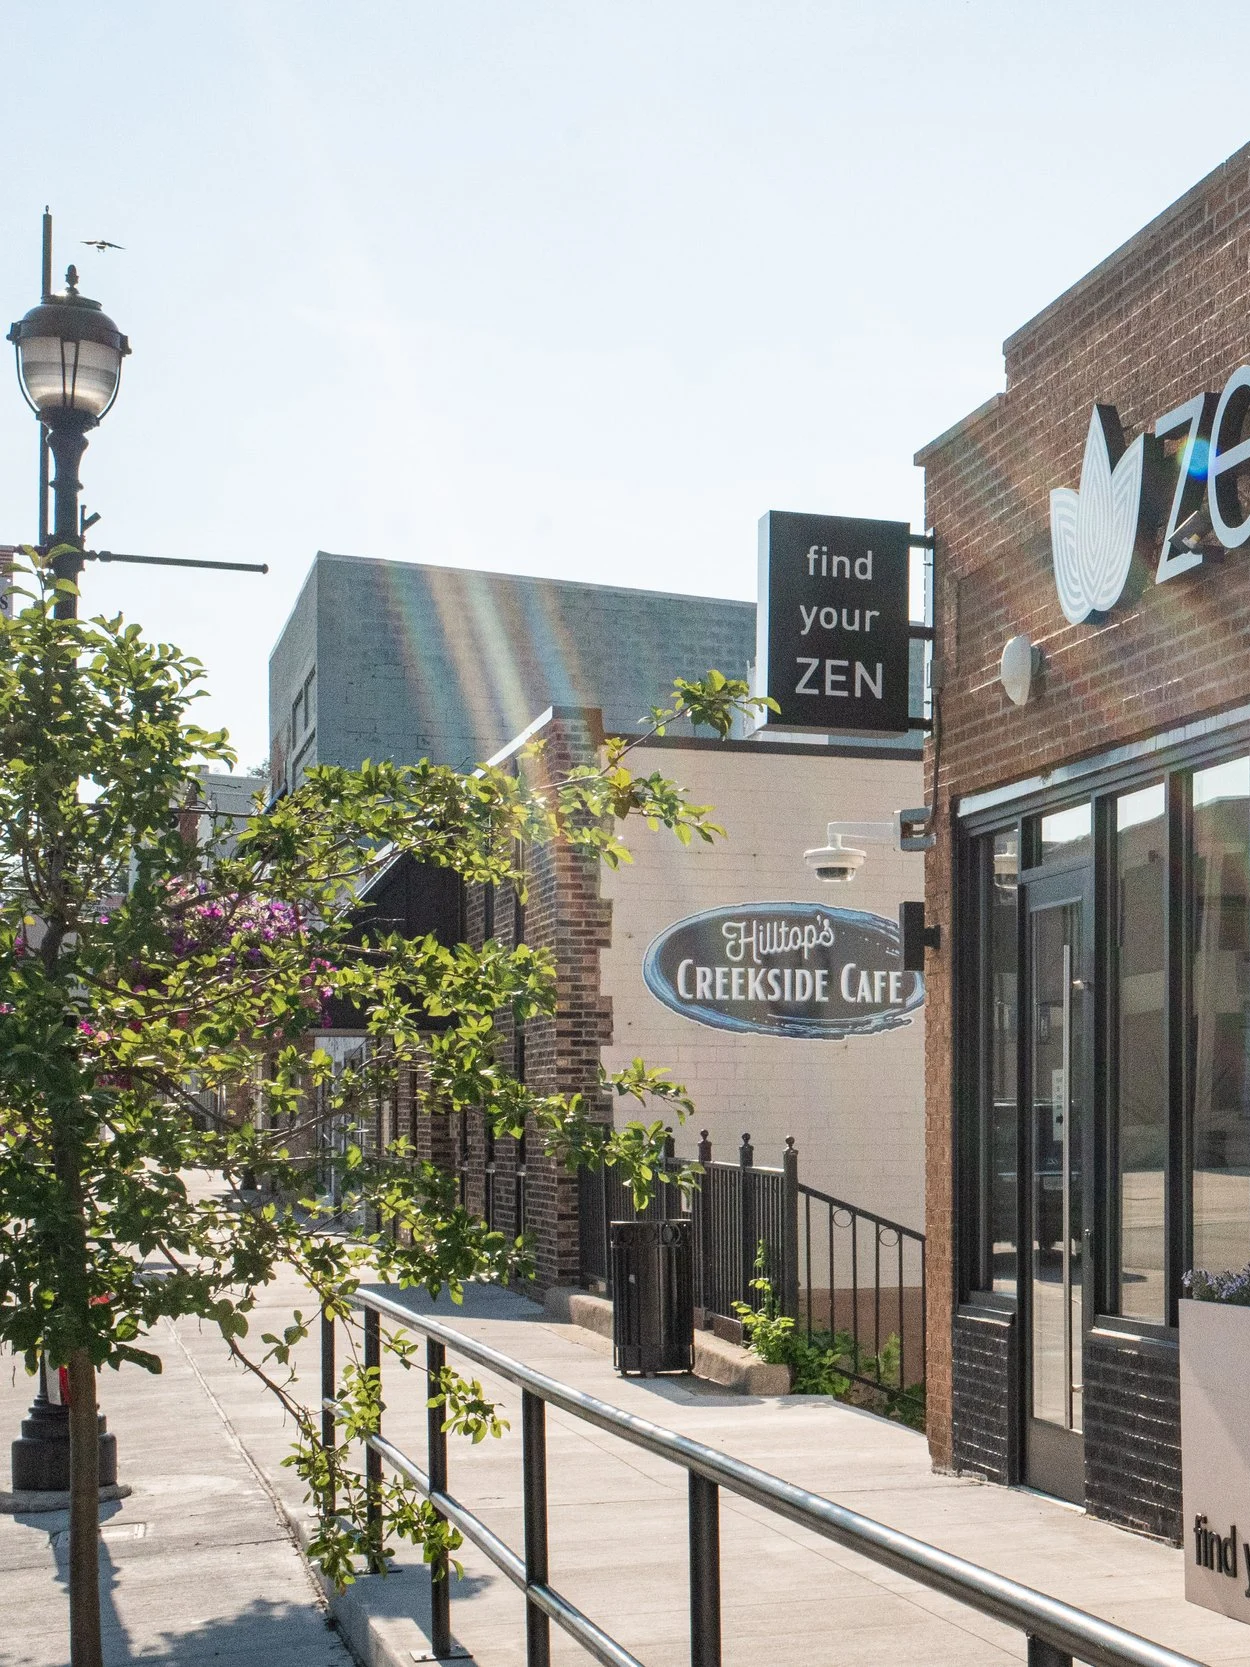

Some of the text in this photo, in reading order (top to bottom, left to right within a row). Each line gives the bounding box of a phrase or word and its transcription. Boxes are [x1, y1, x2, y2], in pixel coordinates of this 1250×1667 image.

[806, 545, 873, 581] find
[799, 604, 880, 636] your
[795, 656, 883, 700] ZEN
[721, 914, 835, 964] Hilltop's
[676, 959, 903, 1004] CREEKSIDE CAFE
[1193, 1512, 1237, 1578] find
